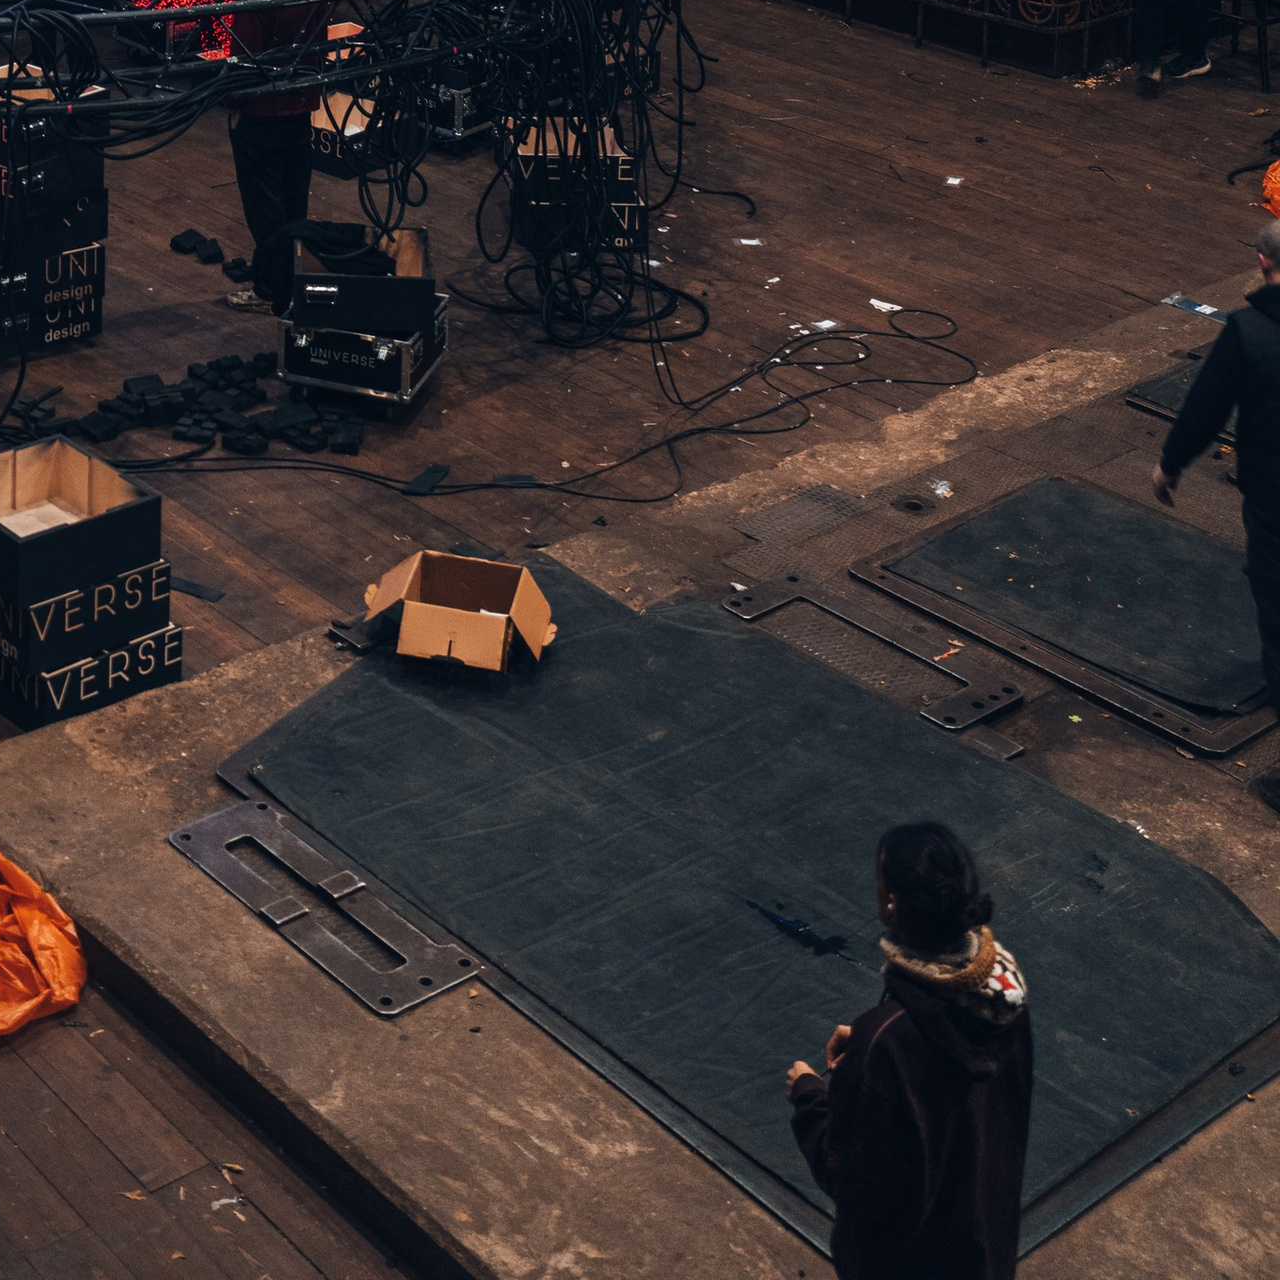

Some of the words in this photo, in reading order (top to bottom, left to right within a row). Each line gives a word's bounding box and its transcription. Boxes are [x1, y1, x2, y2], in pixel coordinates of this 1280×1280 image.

[45, 248, 98, 285] UNI
[43, 283, 93, 305] design
[44, 320, 91, 343] design
[310, 346, 376, 369] UNIVERSE
